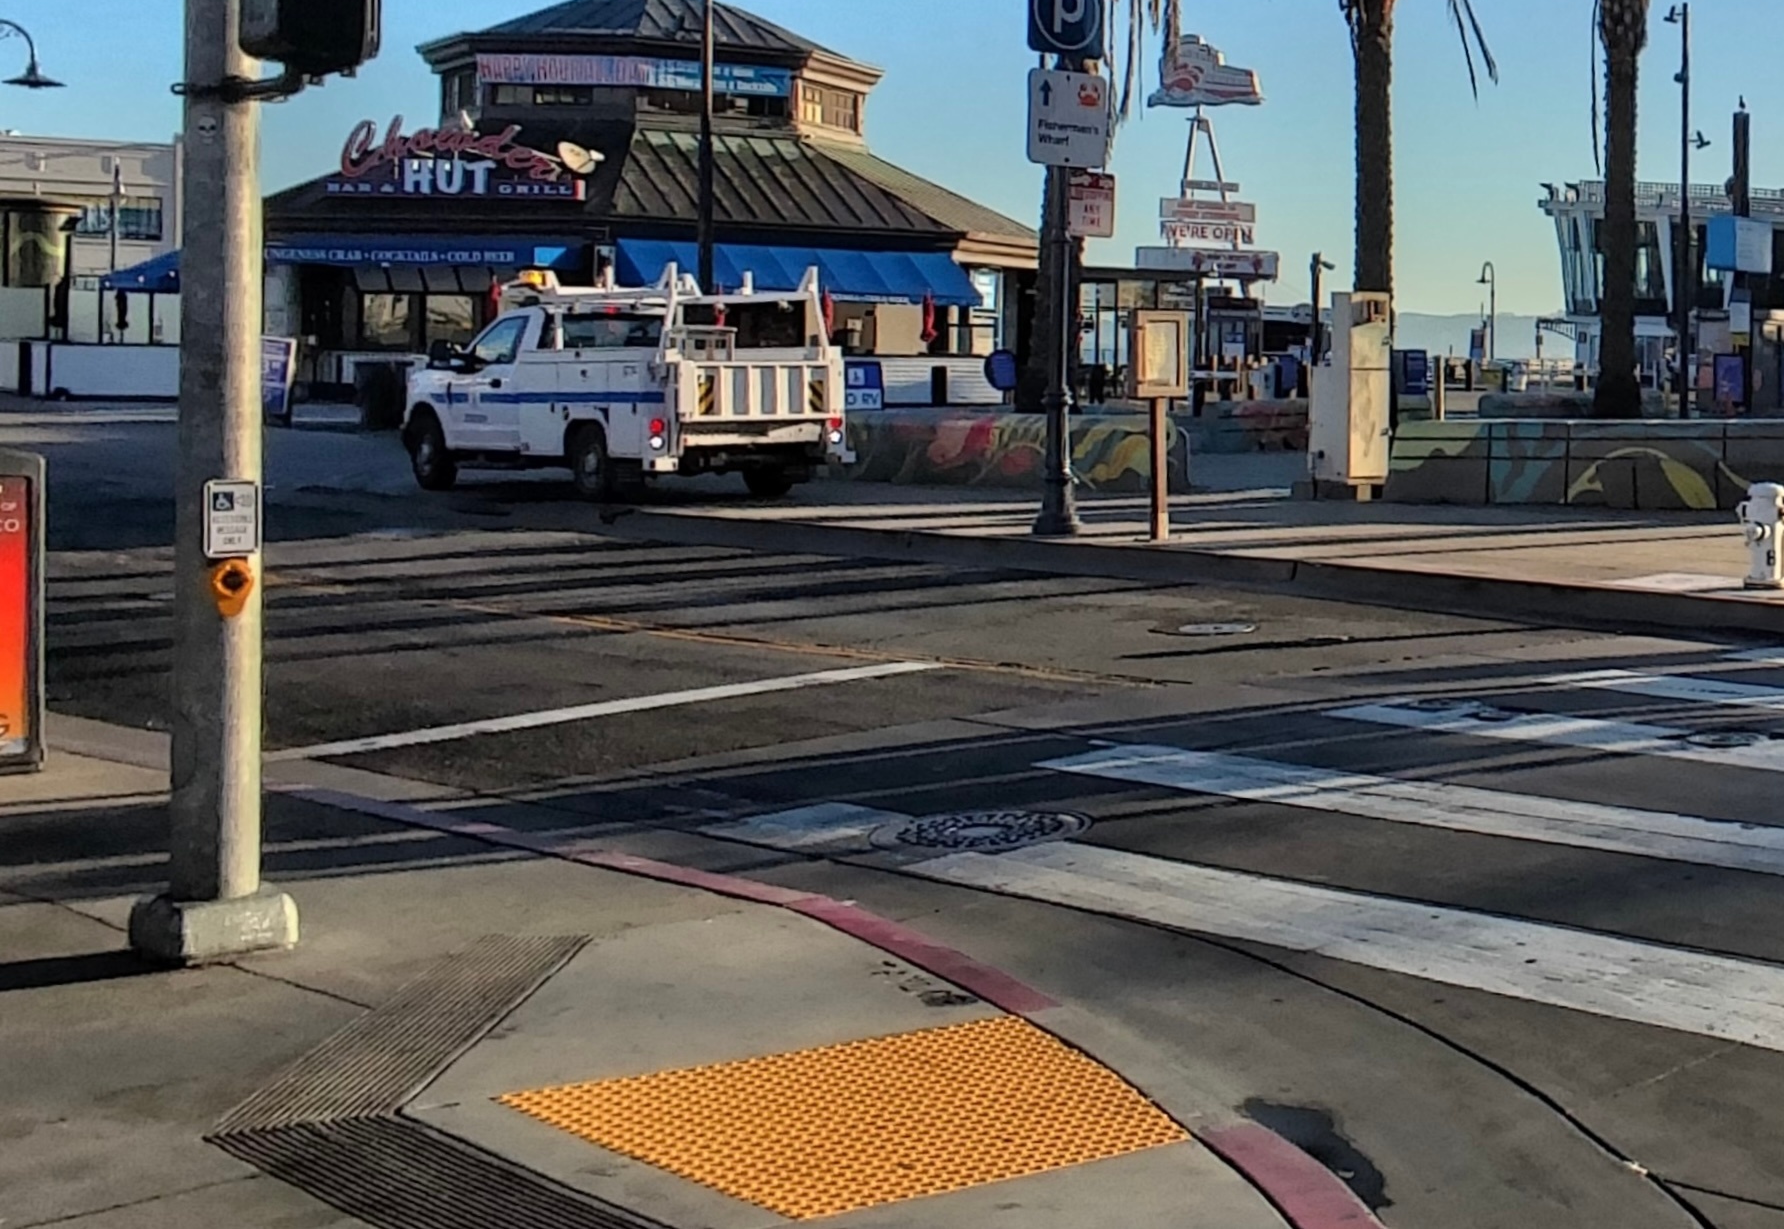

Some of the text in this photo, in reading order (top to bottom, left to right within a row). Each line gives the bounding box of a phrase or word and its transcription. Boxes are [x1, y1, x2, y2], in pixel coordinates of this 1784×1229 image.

[1037, 133, 1069, 146] Wharf
[341, 114, 557, 181] Chowder
[403, 158, 497, 195] HUT
[326, 182, 574, 195] BAR & GRILL
[1165, 224, 1209, 240] WE'RE
[329, 249, 362, 261] CRAB
[447, 251, 481, 262] COLD
